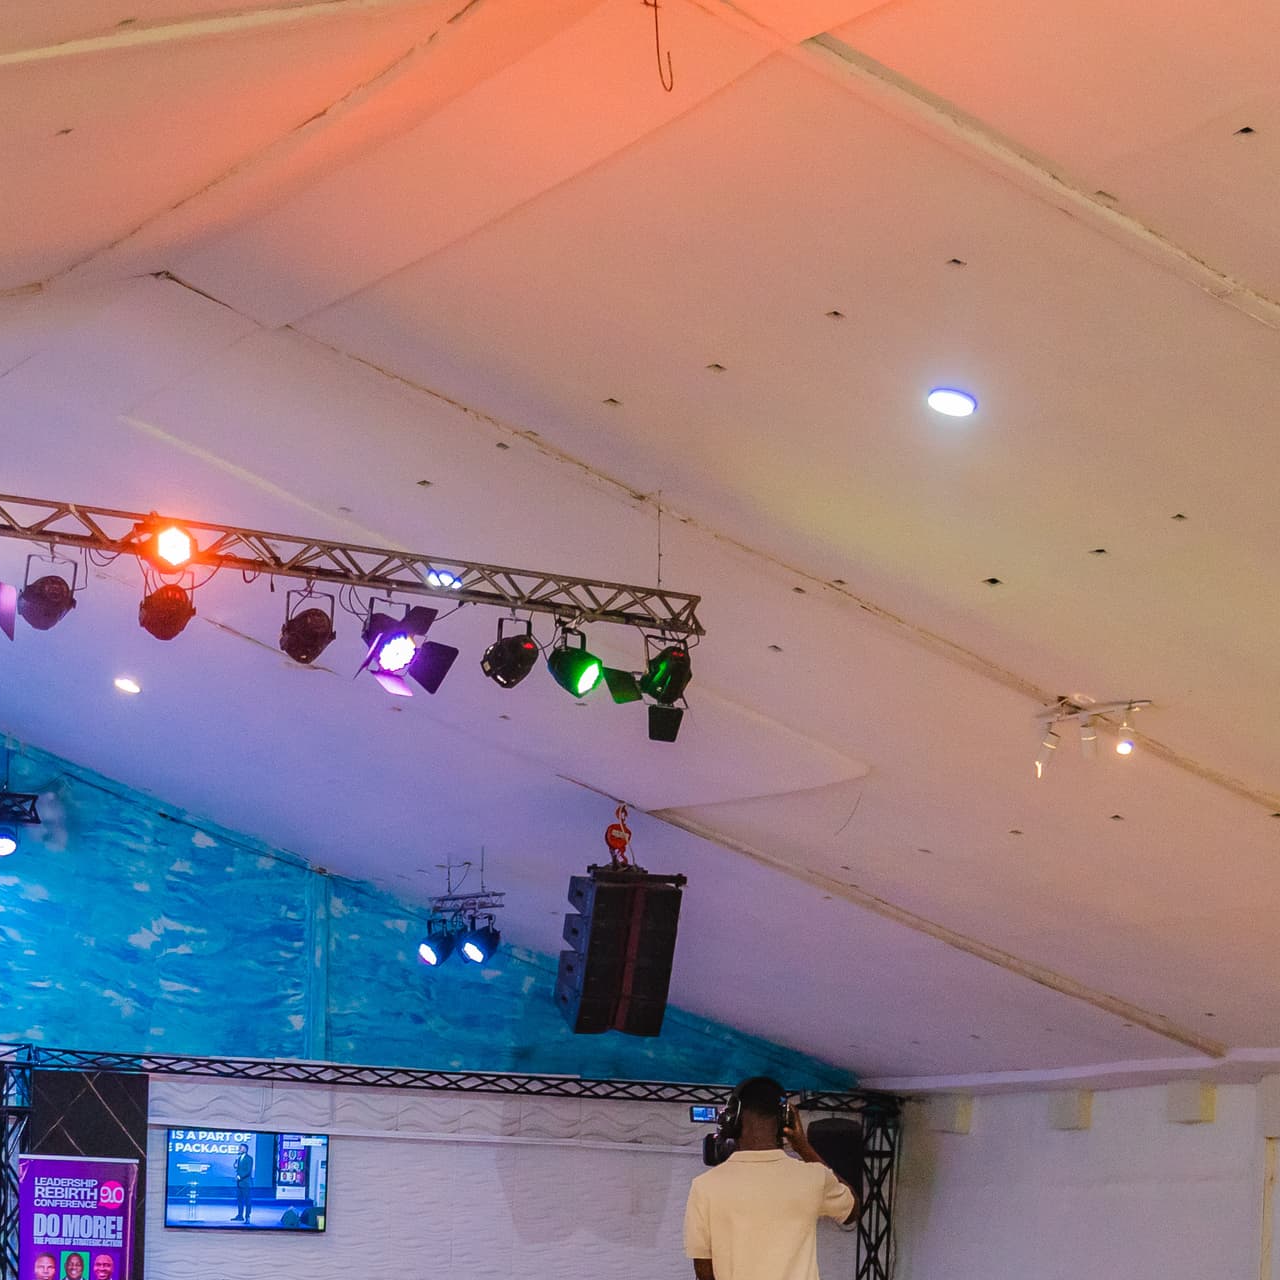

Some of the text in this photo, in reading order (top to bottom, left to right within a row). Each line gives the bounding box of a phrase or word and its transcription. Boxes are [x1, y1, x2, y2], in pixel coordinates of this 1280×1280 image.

[172, 1131, 252, 1142] IS A PART OF
[34, 1177, 98, 1187] LEADERSHIP
[34, 1186, 125, 1204] REBIRTH 9.0
[34, 1199, 98, 1209] CONFERENCE
[33, 1213, 124, 1239] DO MORE!
